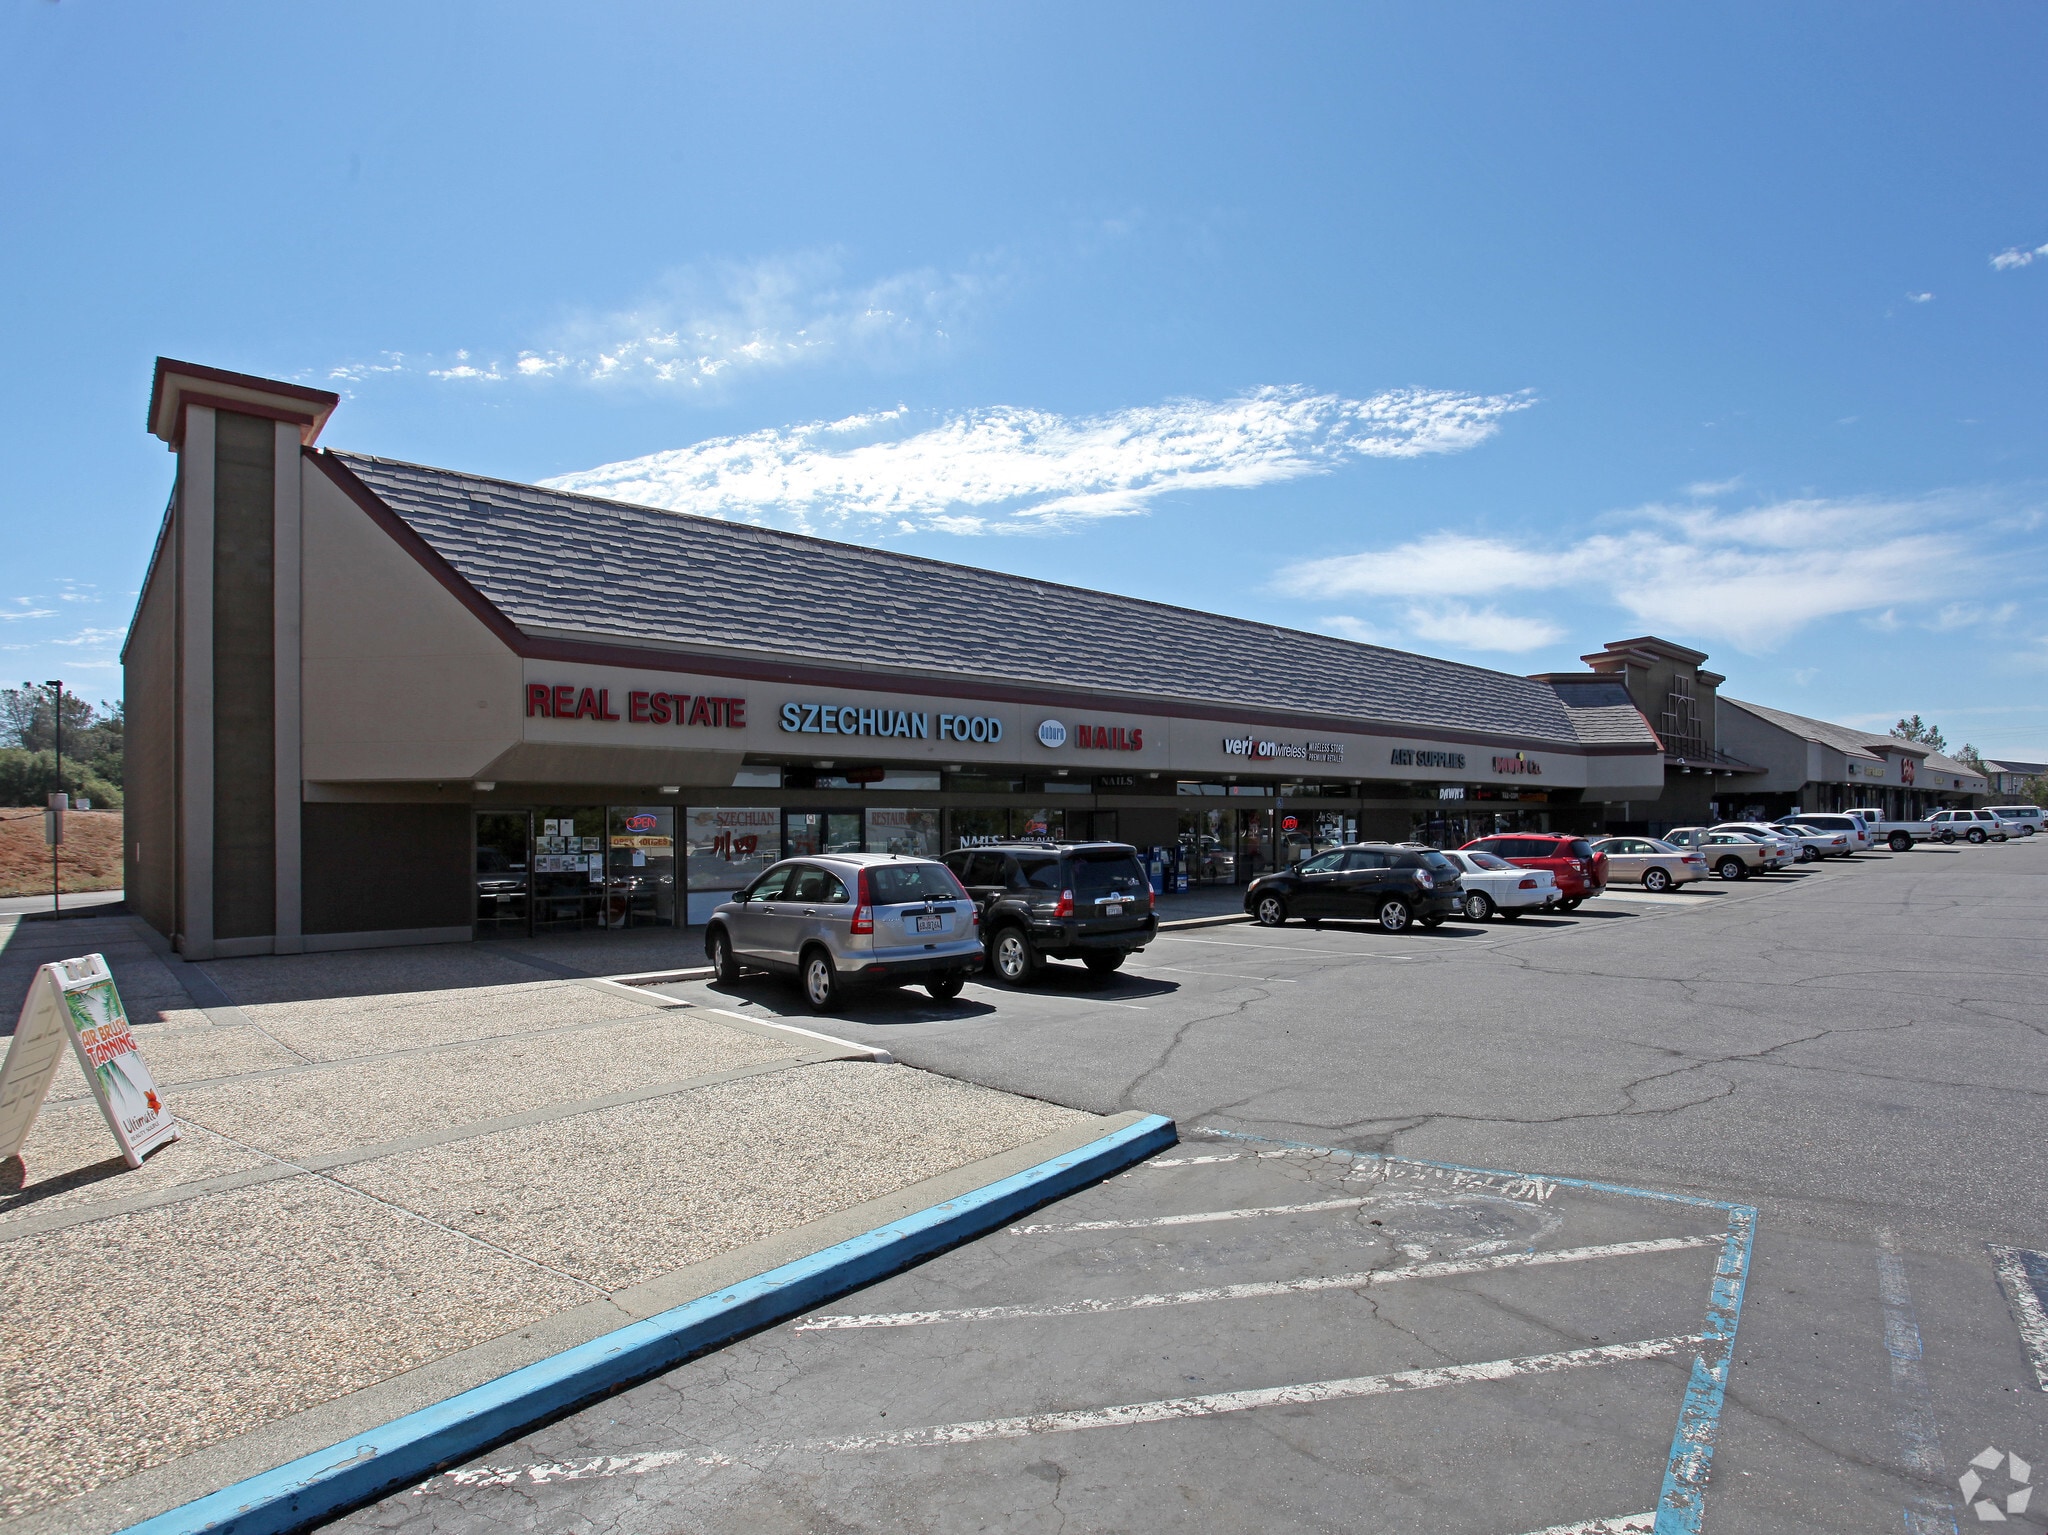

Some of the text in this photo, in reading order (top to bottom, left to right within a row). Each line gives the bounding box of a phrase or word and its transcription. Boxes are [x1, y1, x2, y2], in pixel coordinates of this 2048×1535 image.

[526, 683, 746, 728] REAL ESTATE
[780, 702, 1003, 744] SZECHUAN FOOD
[1041, 725, 1064, 741] Auburn
[1076, 724, 1143, 751] NAILS
[1308, 742, 1344, 754] WIRELESS STORE
[1391, 749, 1466, 769] ART SUPPLIES
[1101, 776, 1133, 786] NAILS
[625, 816, 657, 829] OPEN
[717, 811, 775, 826] SZECHUAN
[1282, 818, 1298, 829] OPEN
[960, 835, 1000, 850] NAILS
[81, 1017, 129, 1048] AIR BRUSH
[86, 1032, 138, 1068] TANNING
[123, 1108, 159, 1134] Ultimate
